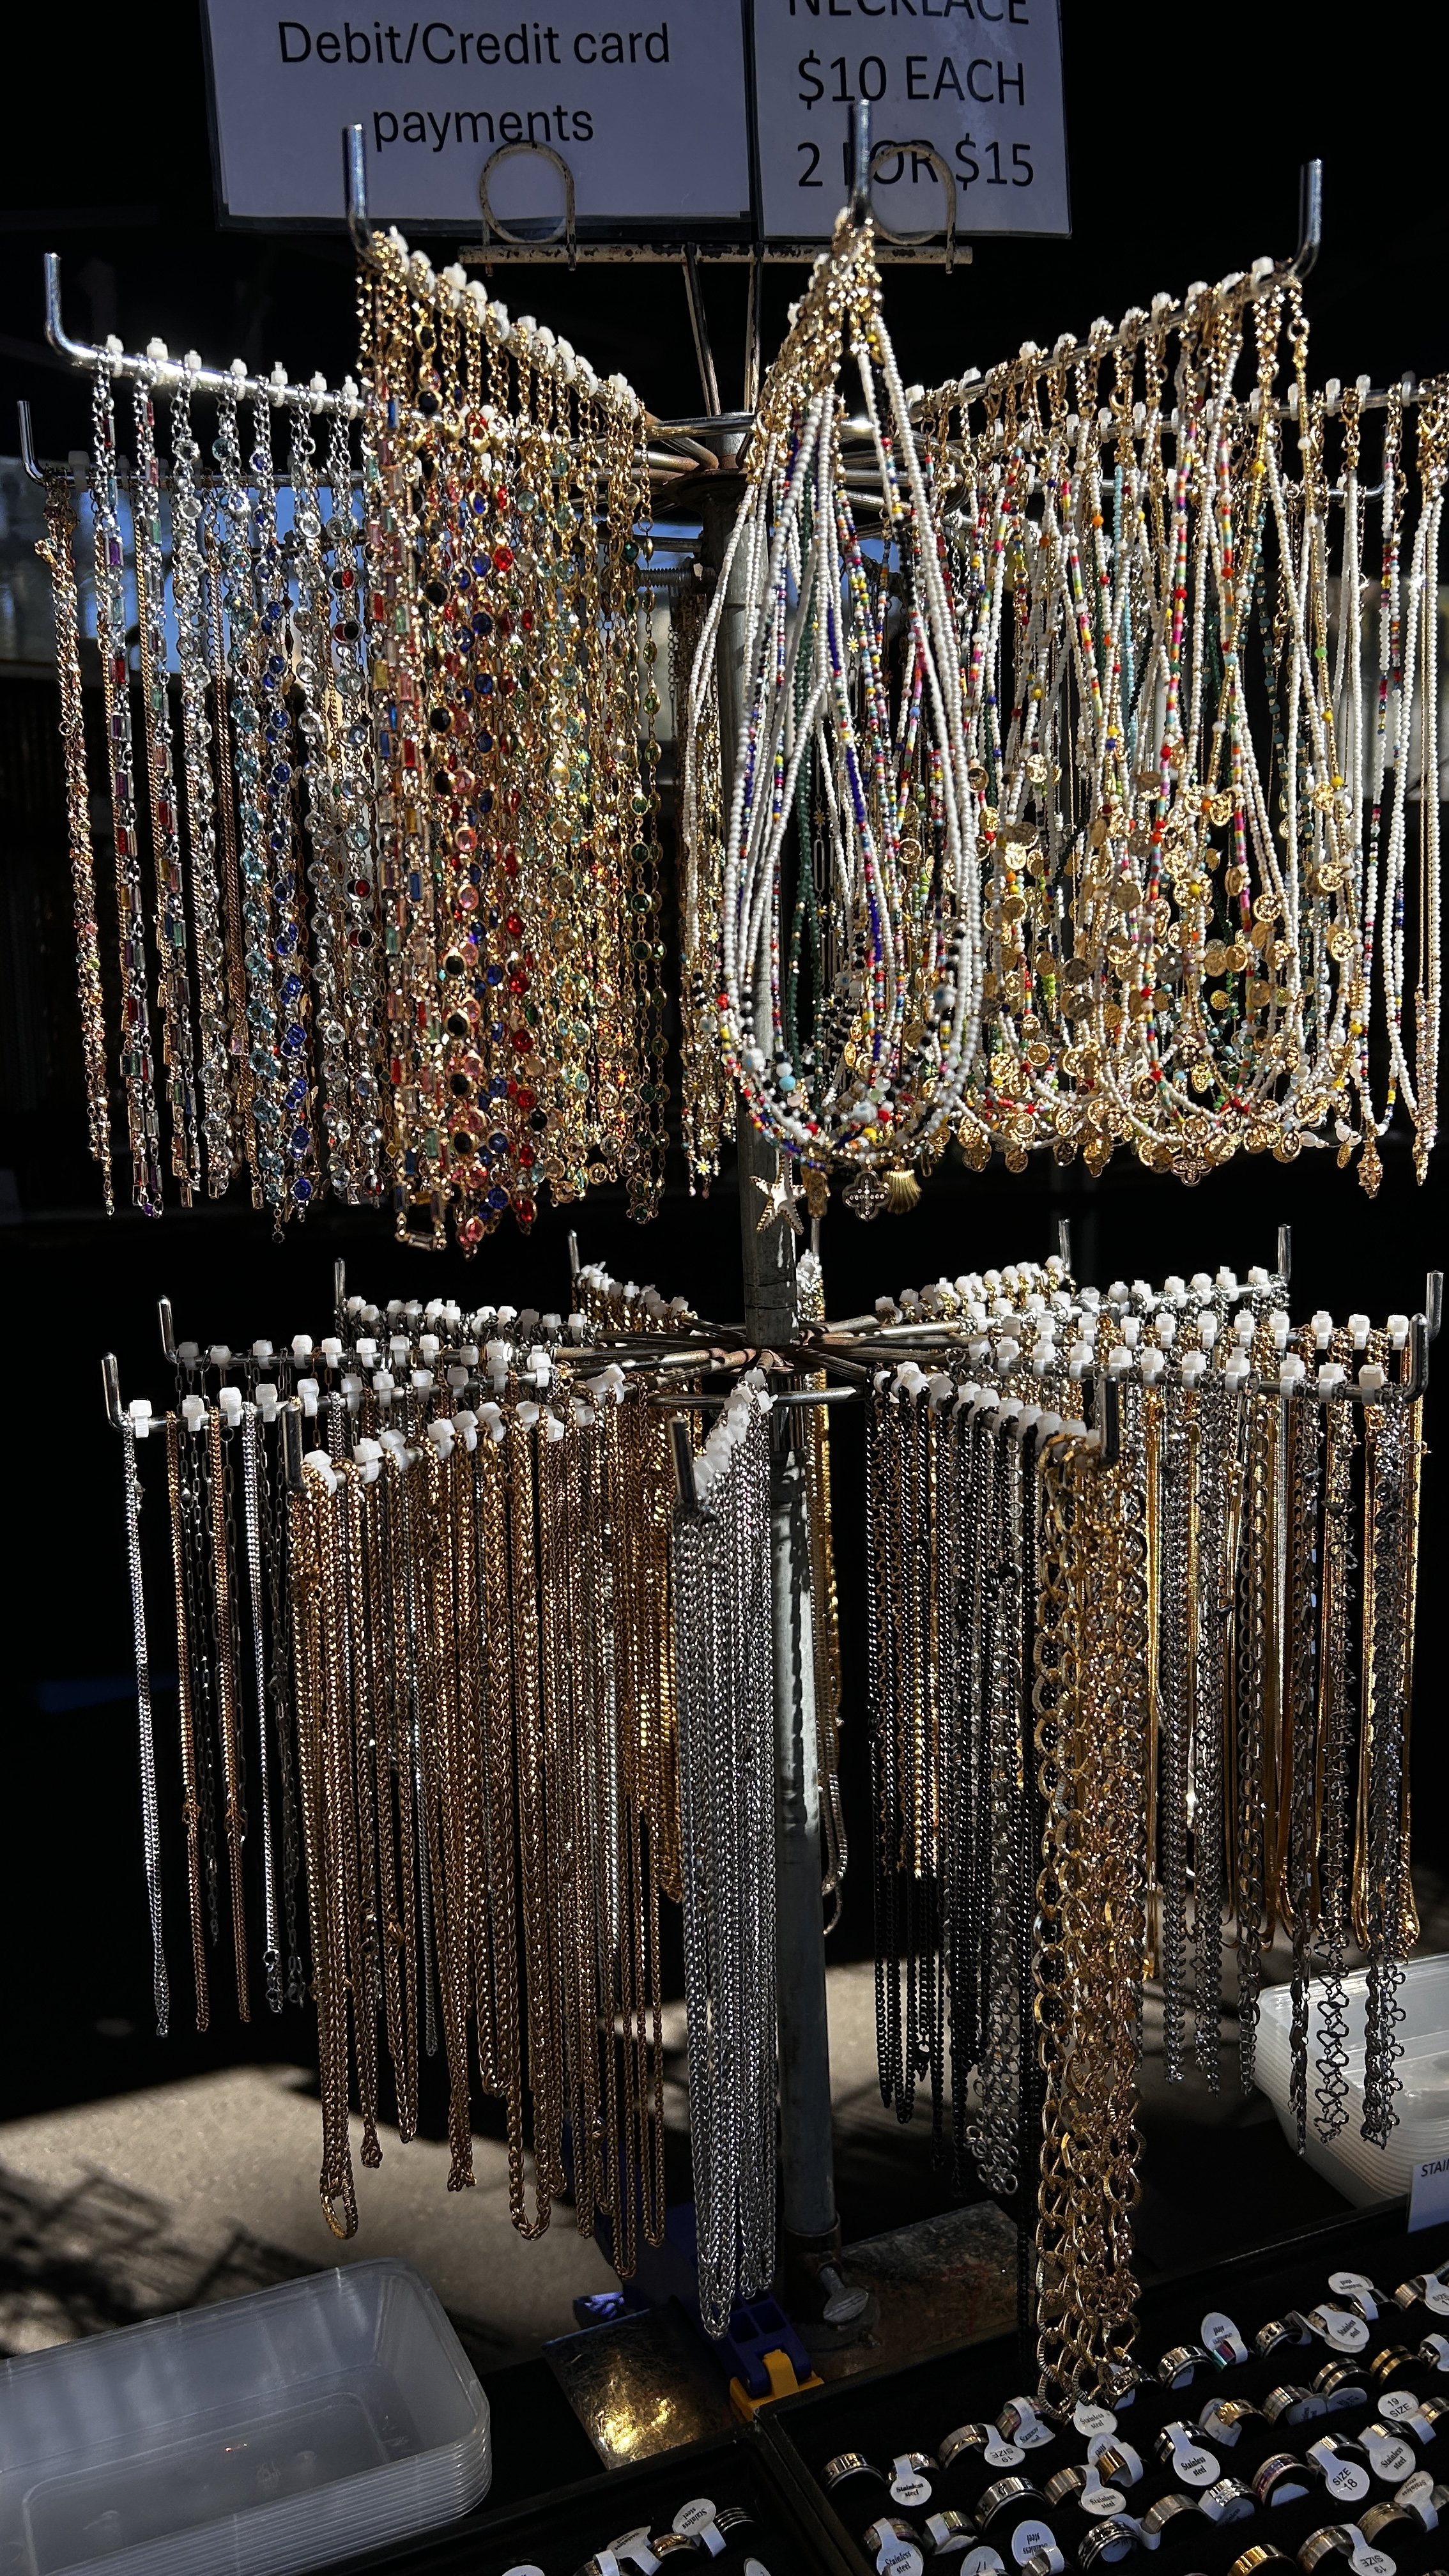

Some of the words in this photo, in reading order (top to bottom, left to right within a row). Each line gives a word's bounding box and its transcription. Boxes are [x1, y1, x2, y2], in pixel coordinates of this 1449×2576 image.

[278, 21, 561, 65] Debit/Credit
[572, 22, 670, 63] card
[798, 49, 887, 110] $10
[906, 56, 1025, 105] EACH
[372, 105, 594, 153] payments
[797, 142, 823, 187] 2
[843, 140, 939, 186] OR
[955, 133, 1034, 190] $15
[1337, 2319, 1356, 2336] Stainless
[1387, 2397, 1399, 2407] 19
[1390, 2402, 1412, 2418] SIZE
[1080, 2412, 1105, 2425] Stainless
[990, 2447, 1014, 2459] SIZE
[1381, 2446, 1404, 2469] Stainless
[1181, 2455, 1206, 2471] Stainless
[1393, 2457, 1407, 2470] steel
[1193, 2465, 1207, 2476] steel
[1332, 2467, 1351, 2486] SIZE
[896, 2482, 924, 2492] Stainless
[1344, 2478, 1358, 2491] 18
[905, 2489, 919, 2497] steel
[1089, 2494, 1116, 2505] Stainless
[682, 2507, 696, 2520] steel
[682, 2508, 707, 2529] Stainless
[1027, 2533, 1040, 2545] steel
[885, 2550, 912, 2566] Stainless
[1360, 2555, 1384, 2567] SIZE
[896, 2561, 911, 2574] steel
[1374, 2564, 1387, 2573] 19
